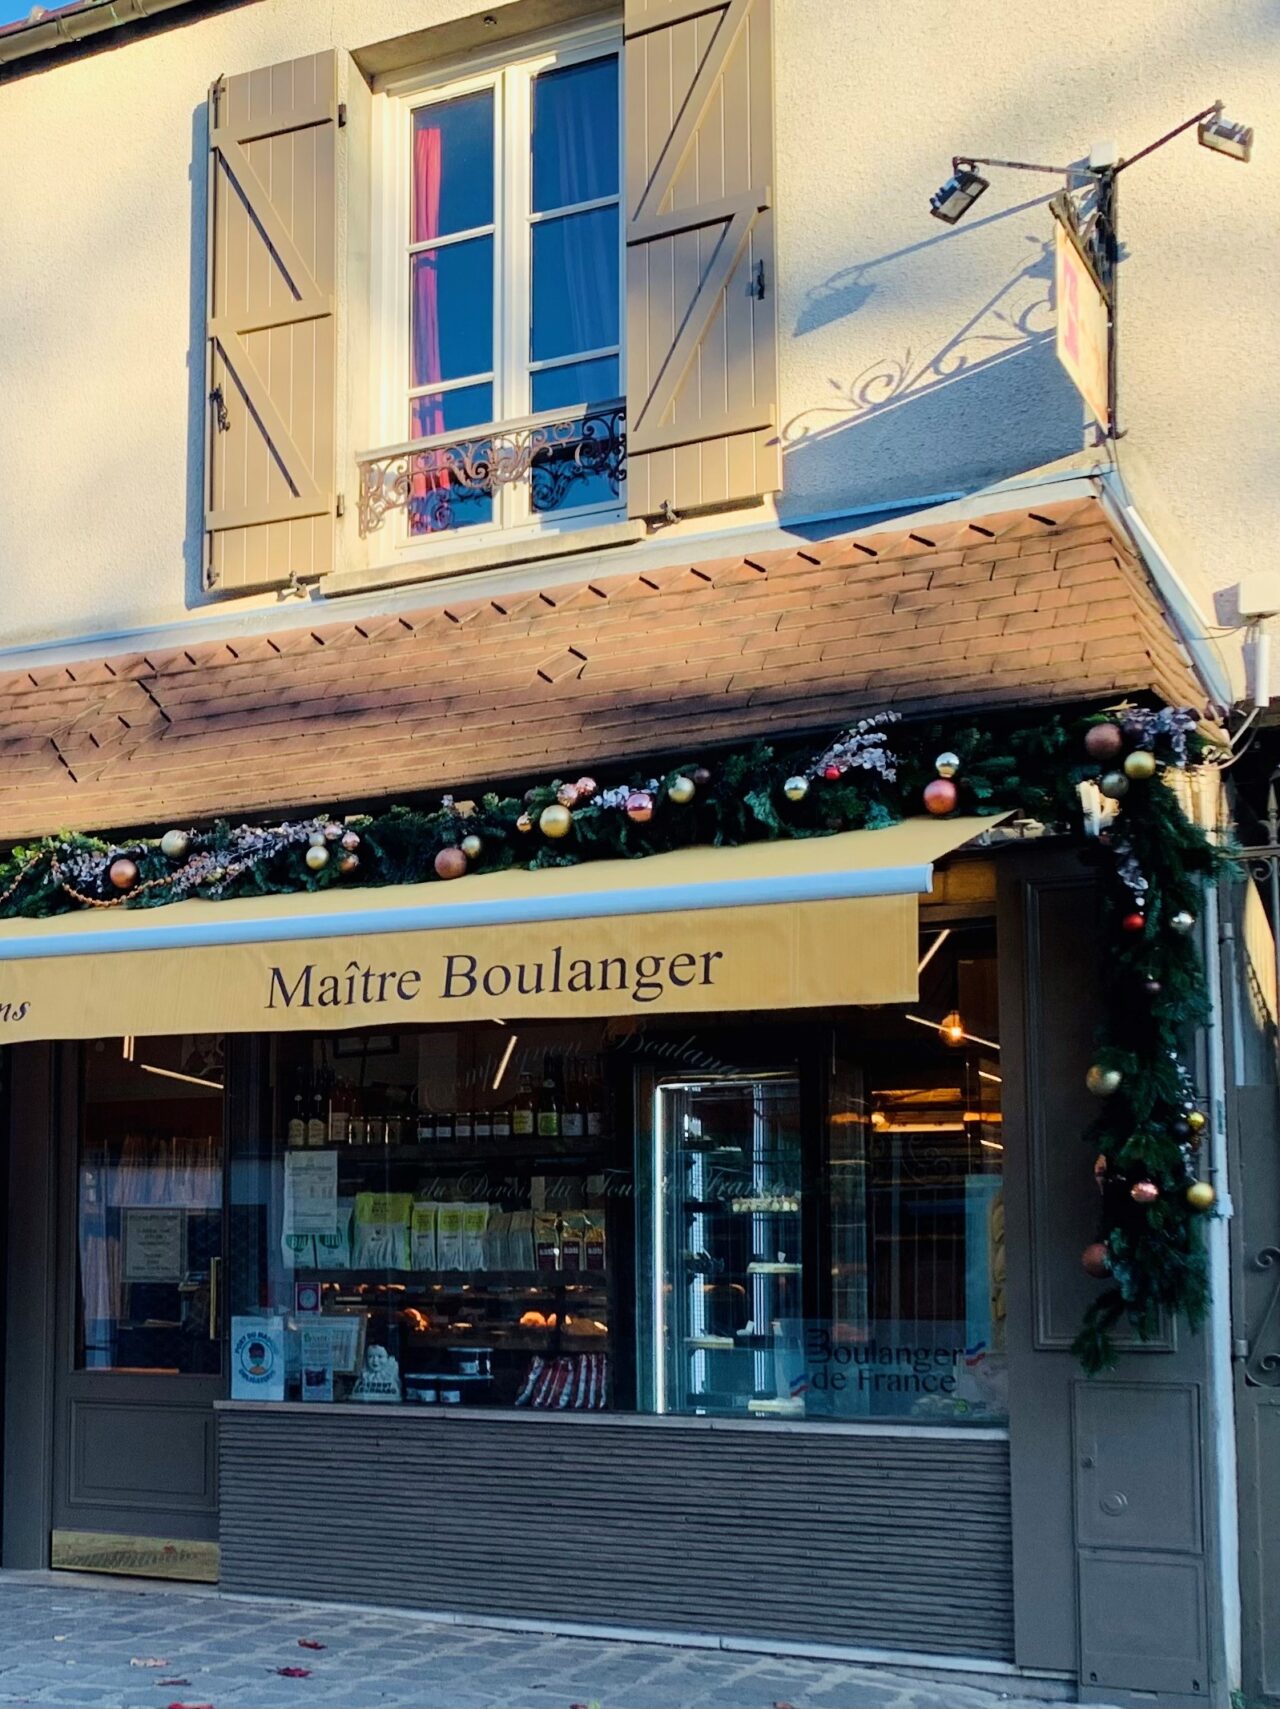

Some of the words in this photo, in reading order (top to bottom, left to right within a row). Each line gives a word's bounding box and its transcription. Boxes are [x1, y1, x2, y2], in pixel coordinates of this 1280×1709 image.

[265, 961, 421, 1008] Maître
[440, 946, 724, 1002] Boulanger
[582, 1167, 632, 1200] Tou
[807, 1328, 964, 1373] Boulanger
[812, 1365, 847, 1391] de
[858, 1368, 956, 1393] France
